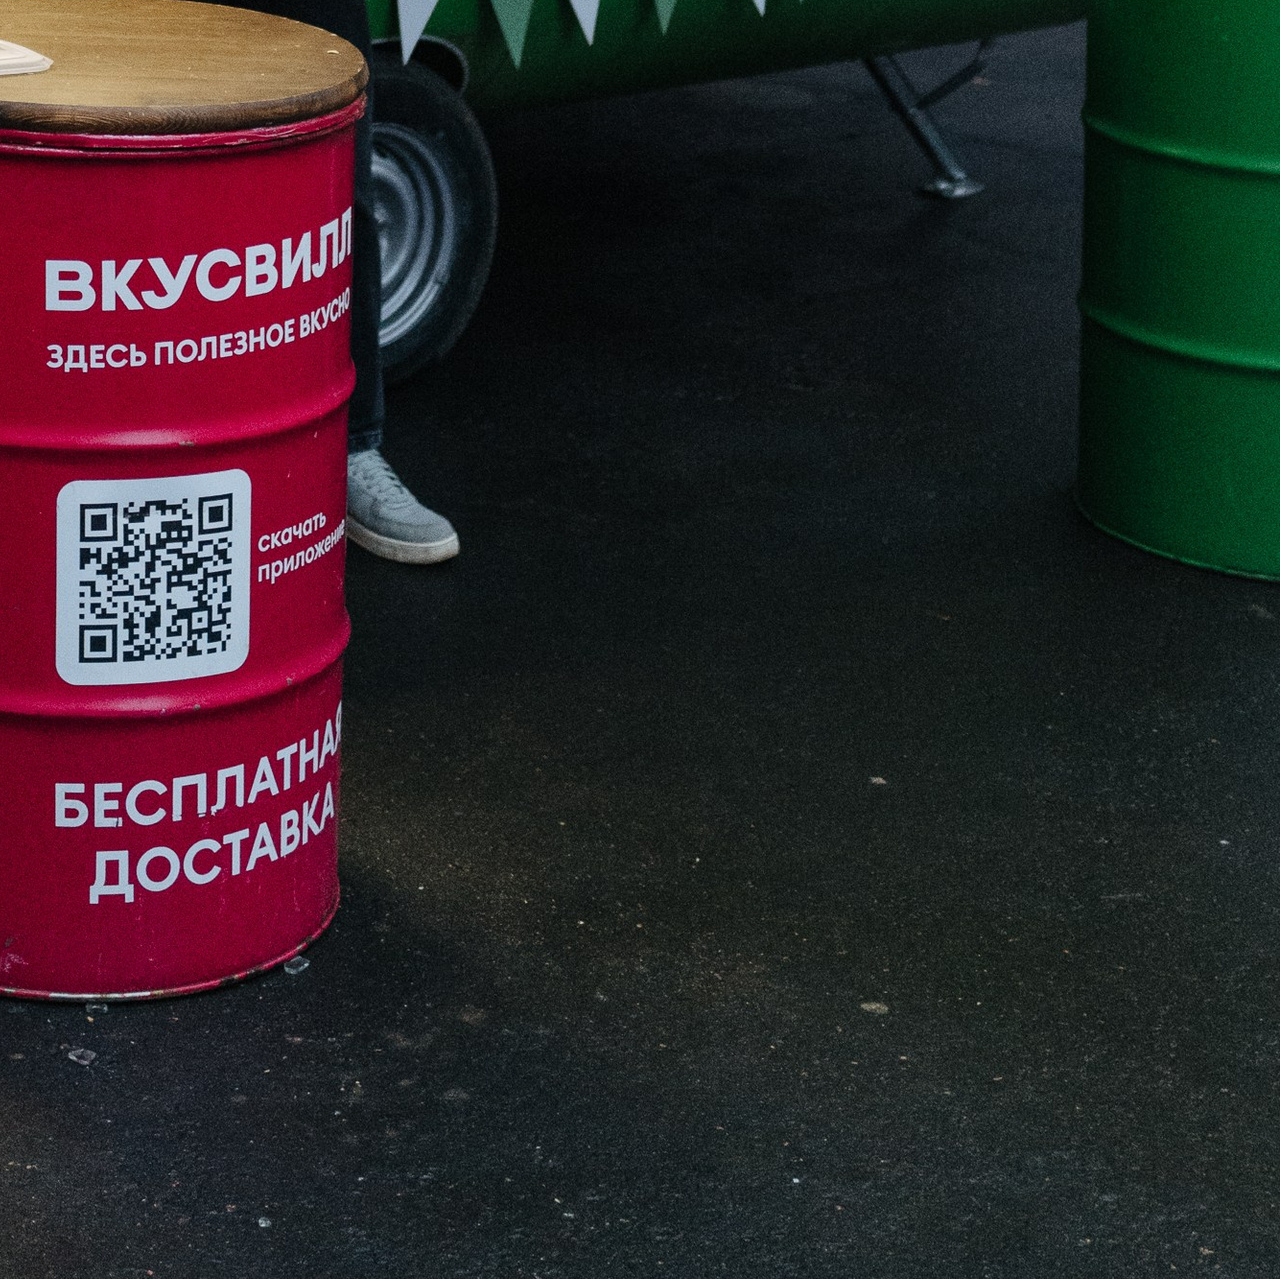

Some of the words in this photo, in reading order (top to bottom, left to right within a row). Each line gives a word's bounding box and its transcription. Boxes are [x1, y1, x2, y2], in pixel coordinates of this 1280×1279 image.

[44, 205, 353, 313] ВКУСВИЛЛ
[45, 342, 147, 373] ЗДЕСЬ
[154, 318, 296, 366] ПОЛЕЗНОЕ
[299, 286, 351, 339] ВКУСНО
[257, 511, 327, 553] скачать
[257, 519, 346, 585] приложение
[88, 781, 336, 905] ДОСТАВКА
